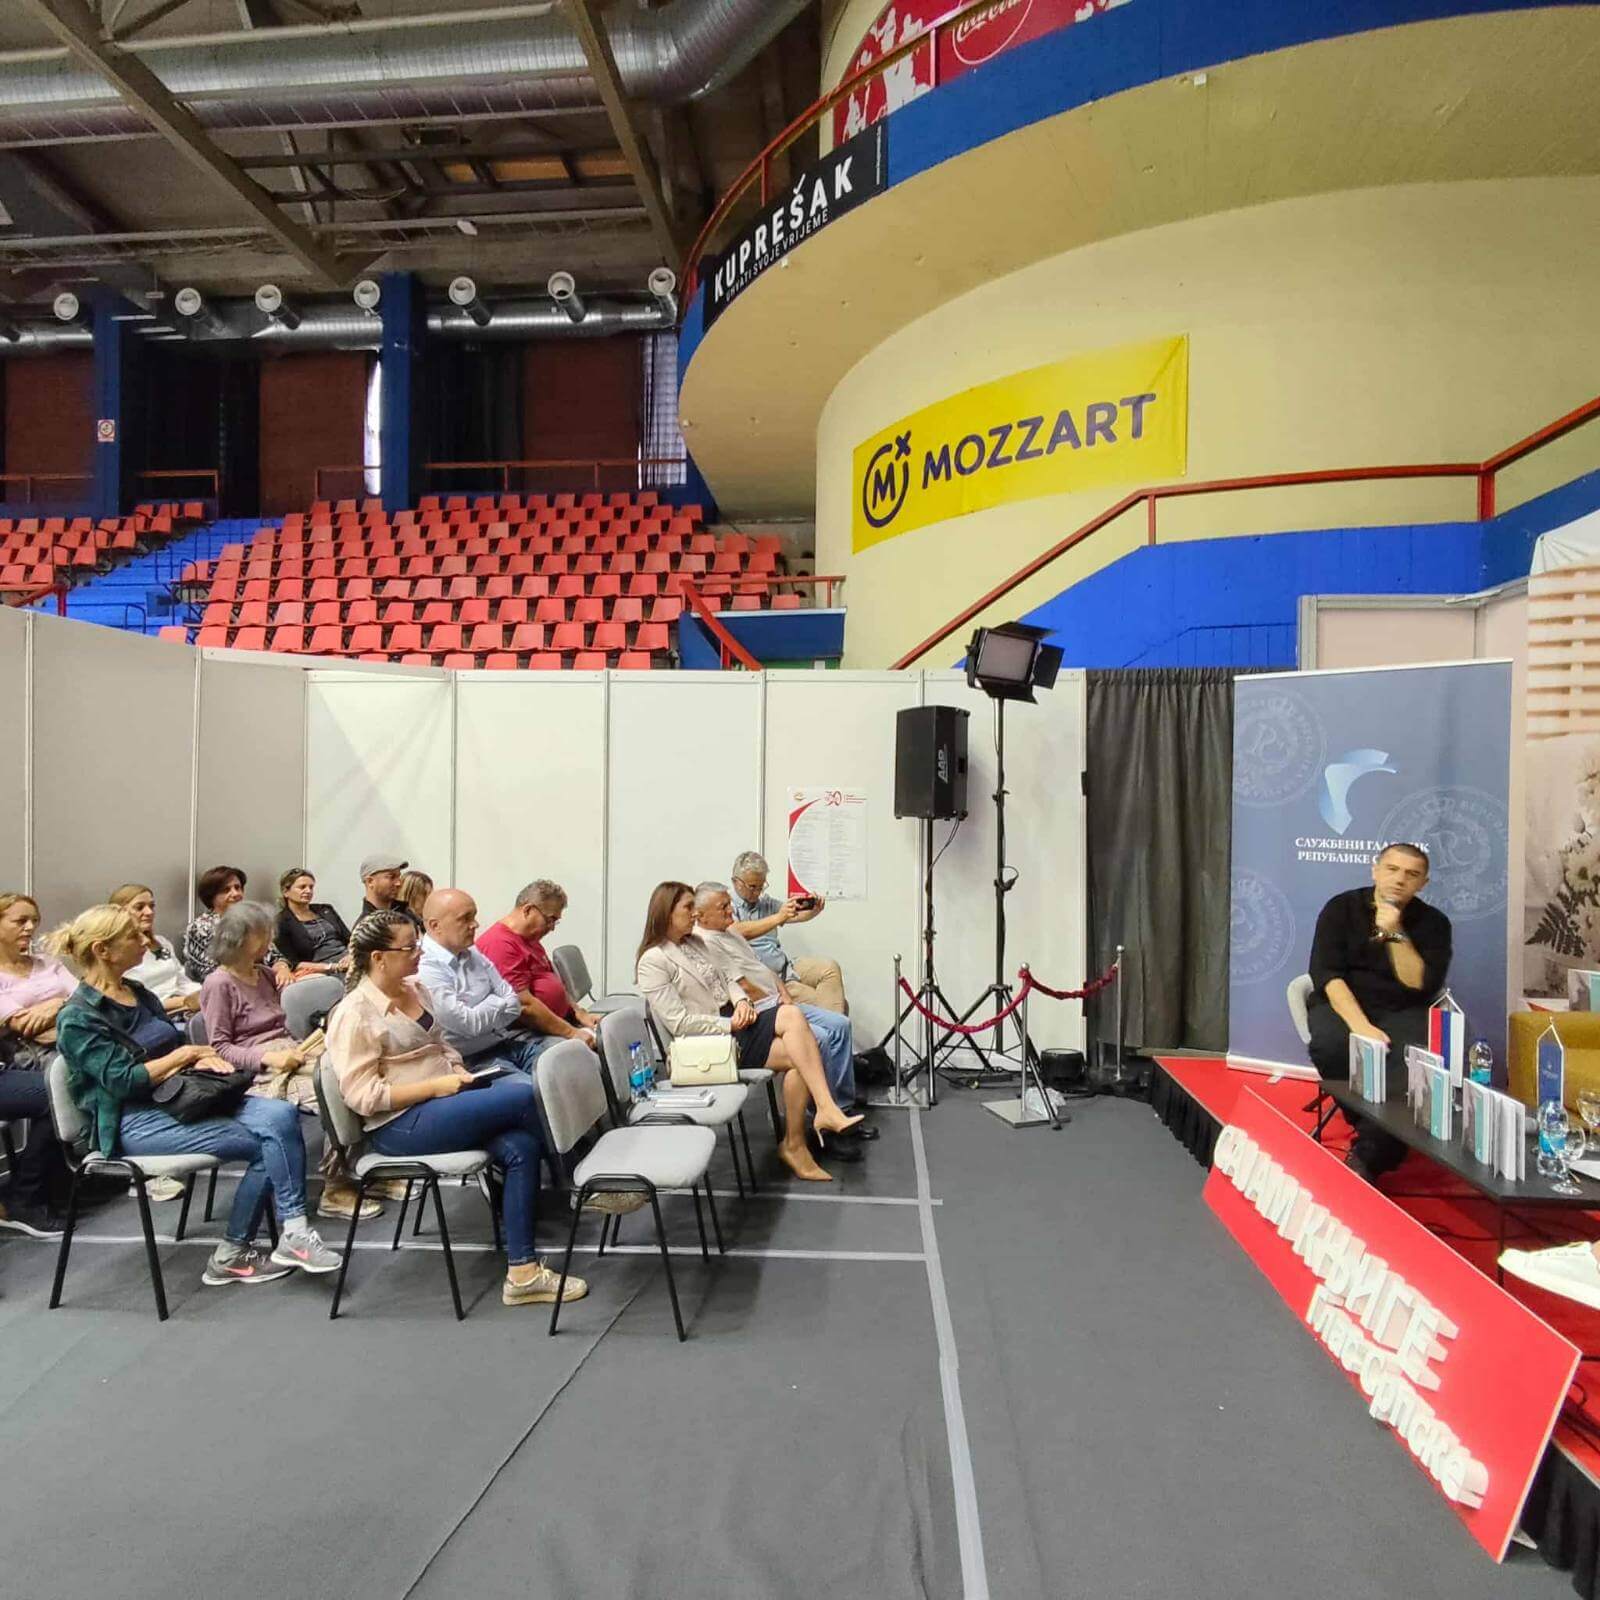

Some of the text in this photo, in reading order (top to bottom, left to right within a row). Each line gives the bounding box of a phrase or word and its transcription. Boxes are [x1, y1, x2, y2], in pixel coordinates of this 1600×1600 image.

[714, 155, 853, 303] KUPREŠAK
[752, 243, 781, 276] SVOJE
[782, 207, 830, 251] VRIJEME
[921, 392, 1157, 490] MOZZART
[1295, 837, 1430, 853] СЛУЖБЕНИ ГЛАК
[1297, 850, 1370, 865] РЕПУБЛИКЕ
[1214, 1124, 1313, 1240] САЈАМ
[1292, 1202, 1459, 1392] КЊИГЕ
[1358, 1346, 1489, 1510] Српске
